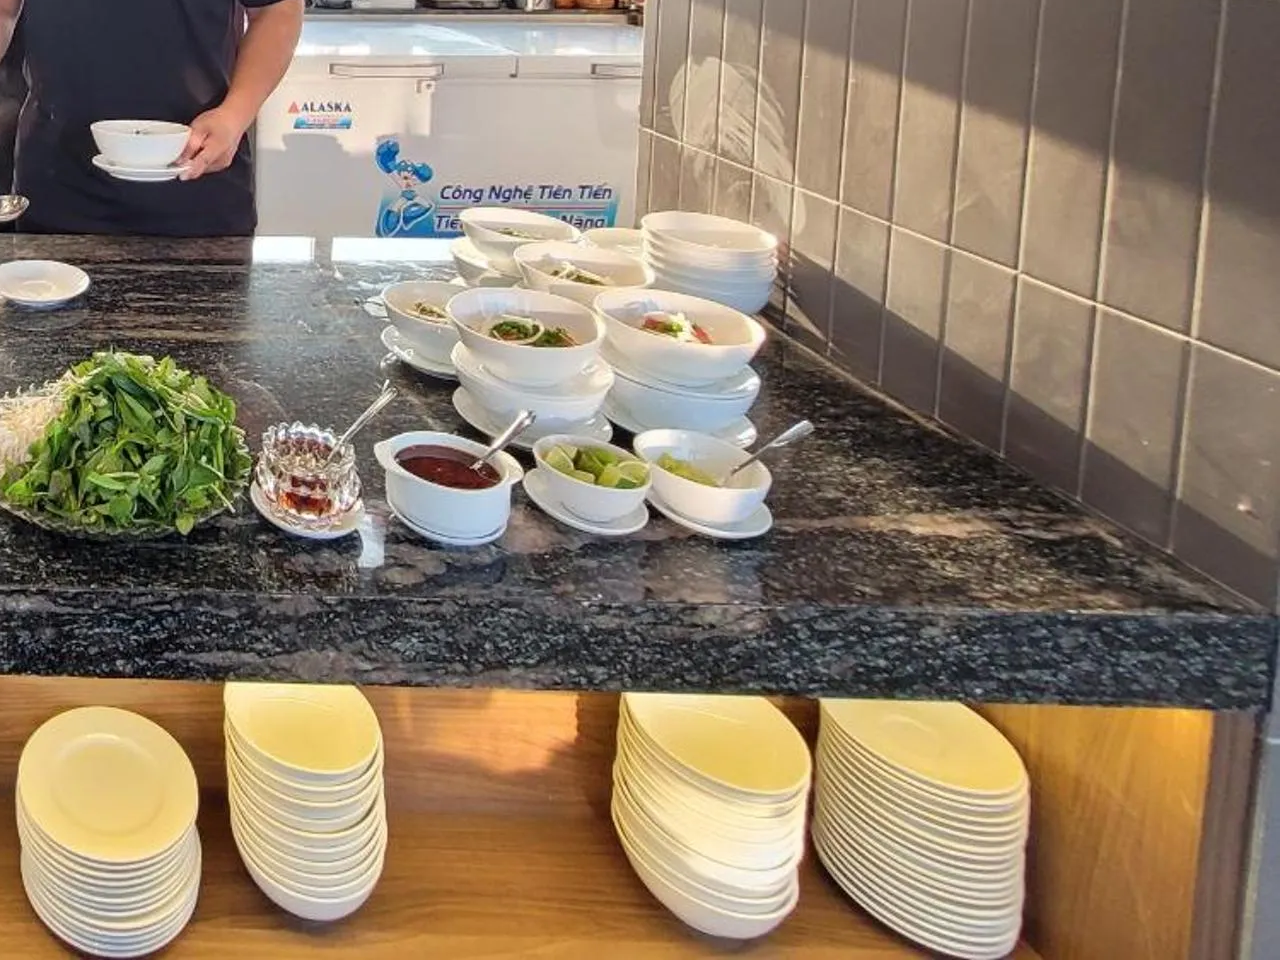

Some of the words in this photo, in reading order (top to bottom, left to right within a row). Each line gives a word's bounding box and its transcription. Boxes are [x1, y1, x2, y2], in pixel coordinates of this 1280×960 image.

[301, 101, 352, 113] ALASKA
[439, 184, 484, 203] Công
[487, 184, 534, 204] Nghệ
[578, 182, 613, 200] Tiến
